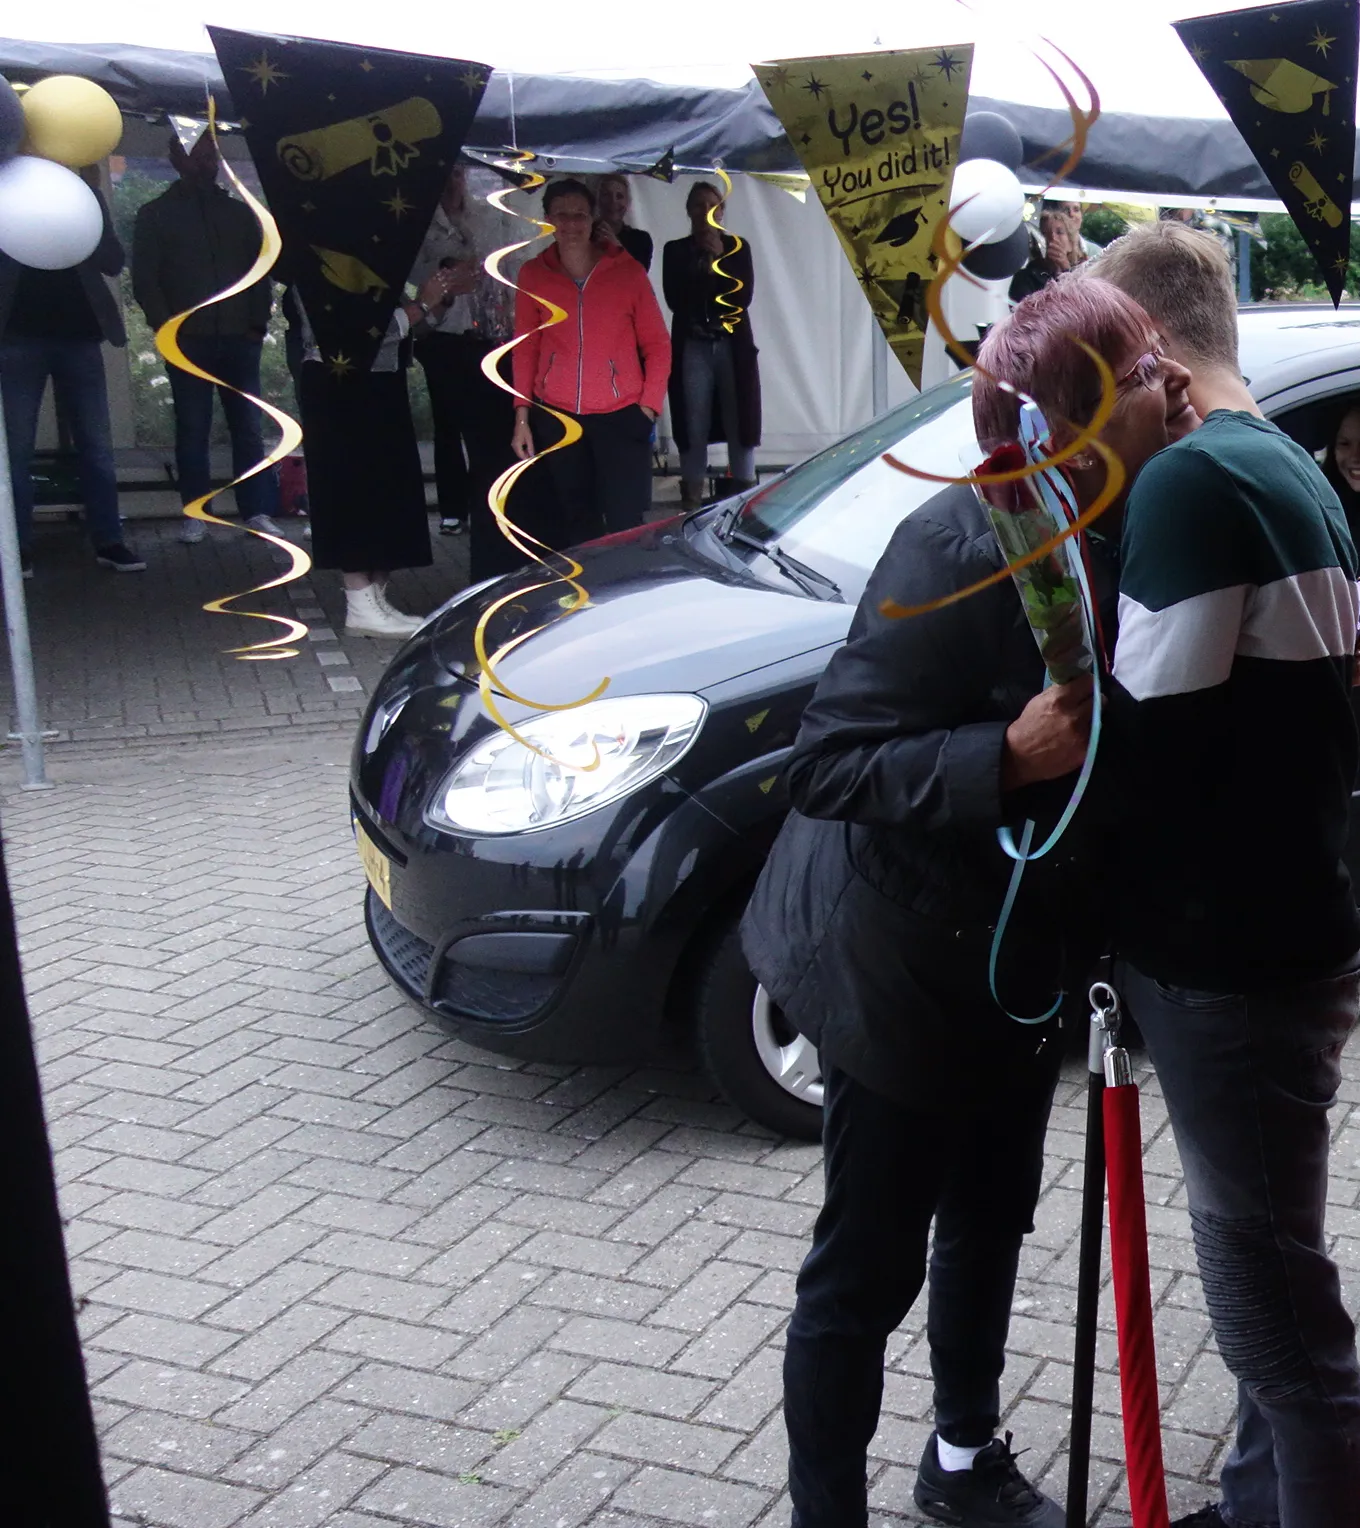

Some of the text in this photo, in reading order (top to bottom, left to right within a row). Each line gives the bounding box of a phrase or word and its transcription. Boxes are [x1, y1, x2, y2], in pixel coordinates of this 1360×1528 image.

[828, 81, 921, 156] Yes!
[823, 136, 950, 197] You did it!
